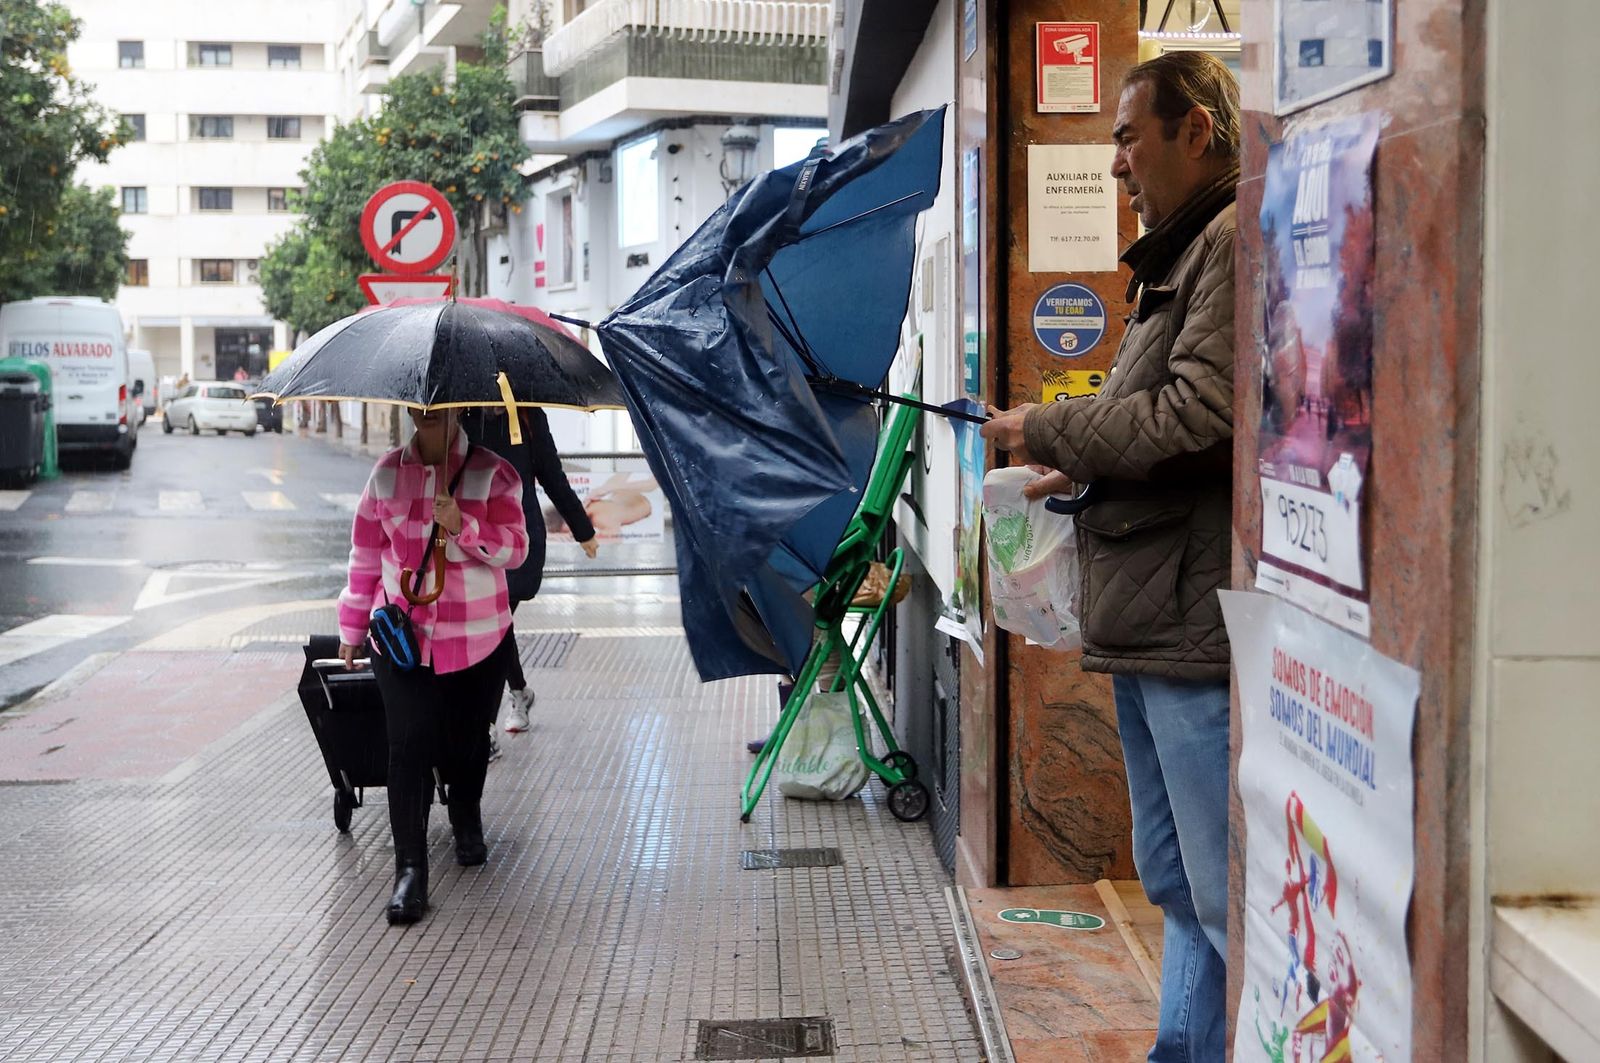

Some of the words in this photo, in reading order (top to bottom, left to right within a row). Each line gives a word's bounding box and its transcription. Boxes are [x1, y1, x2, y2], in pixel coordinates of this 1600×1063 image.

[1046, 173, 1088, 181] AUXILIAR
[1090, 173, 1103, 181] DE
[1045, 184, 1104, 194] ENFERMERÍA
[1046, 298, 1093, 307] VERIFICAMOS
[1055, 306, 1064, 315] TU
[1065, 306, 1084, 315] EDAD
[53, 342, 113, 357] ALVARADO
[1271, 647, 1307, 697] SOMOS
[1309, 666, 1321, 708] DE
[1324, 676, 1375, 742] EMOCIÓN
[1269, 685, 1304, 737] SOMOS
[1306, 707, 1323, 752] DEL
[1325, 721, 1376, 790] MUNDIAL
